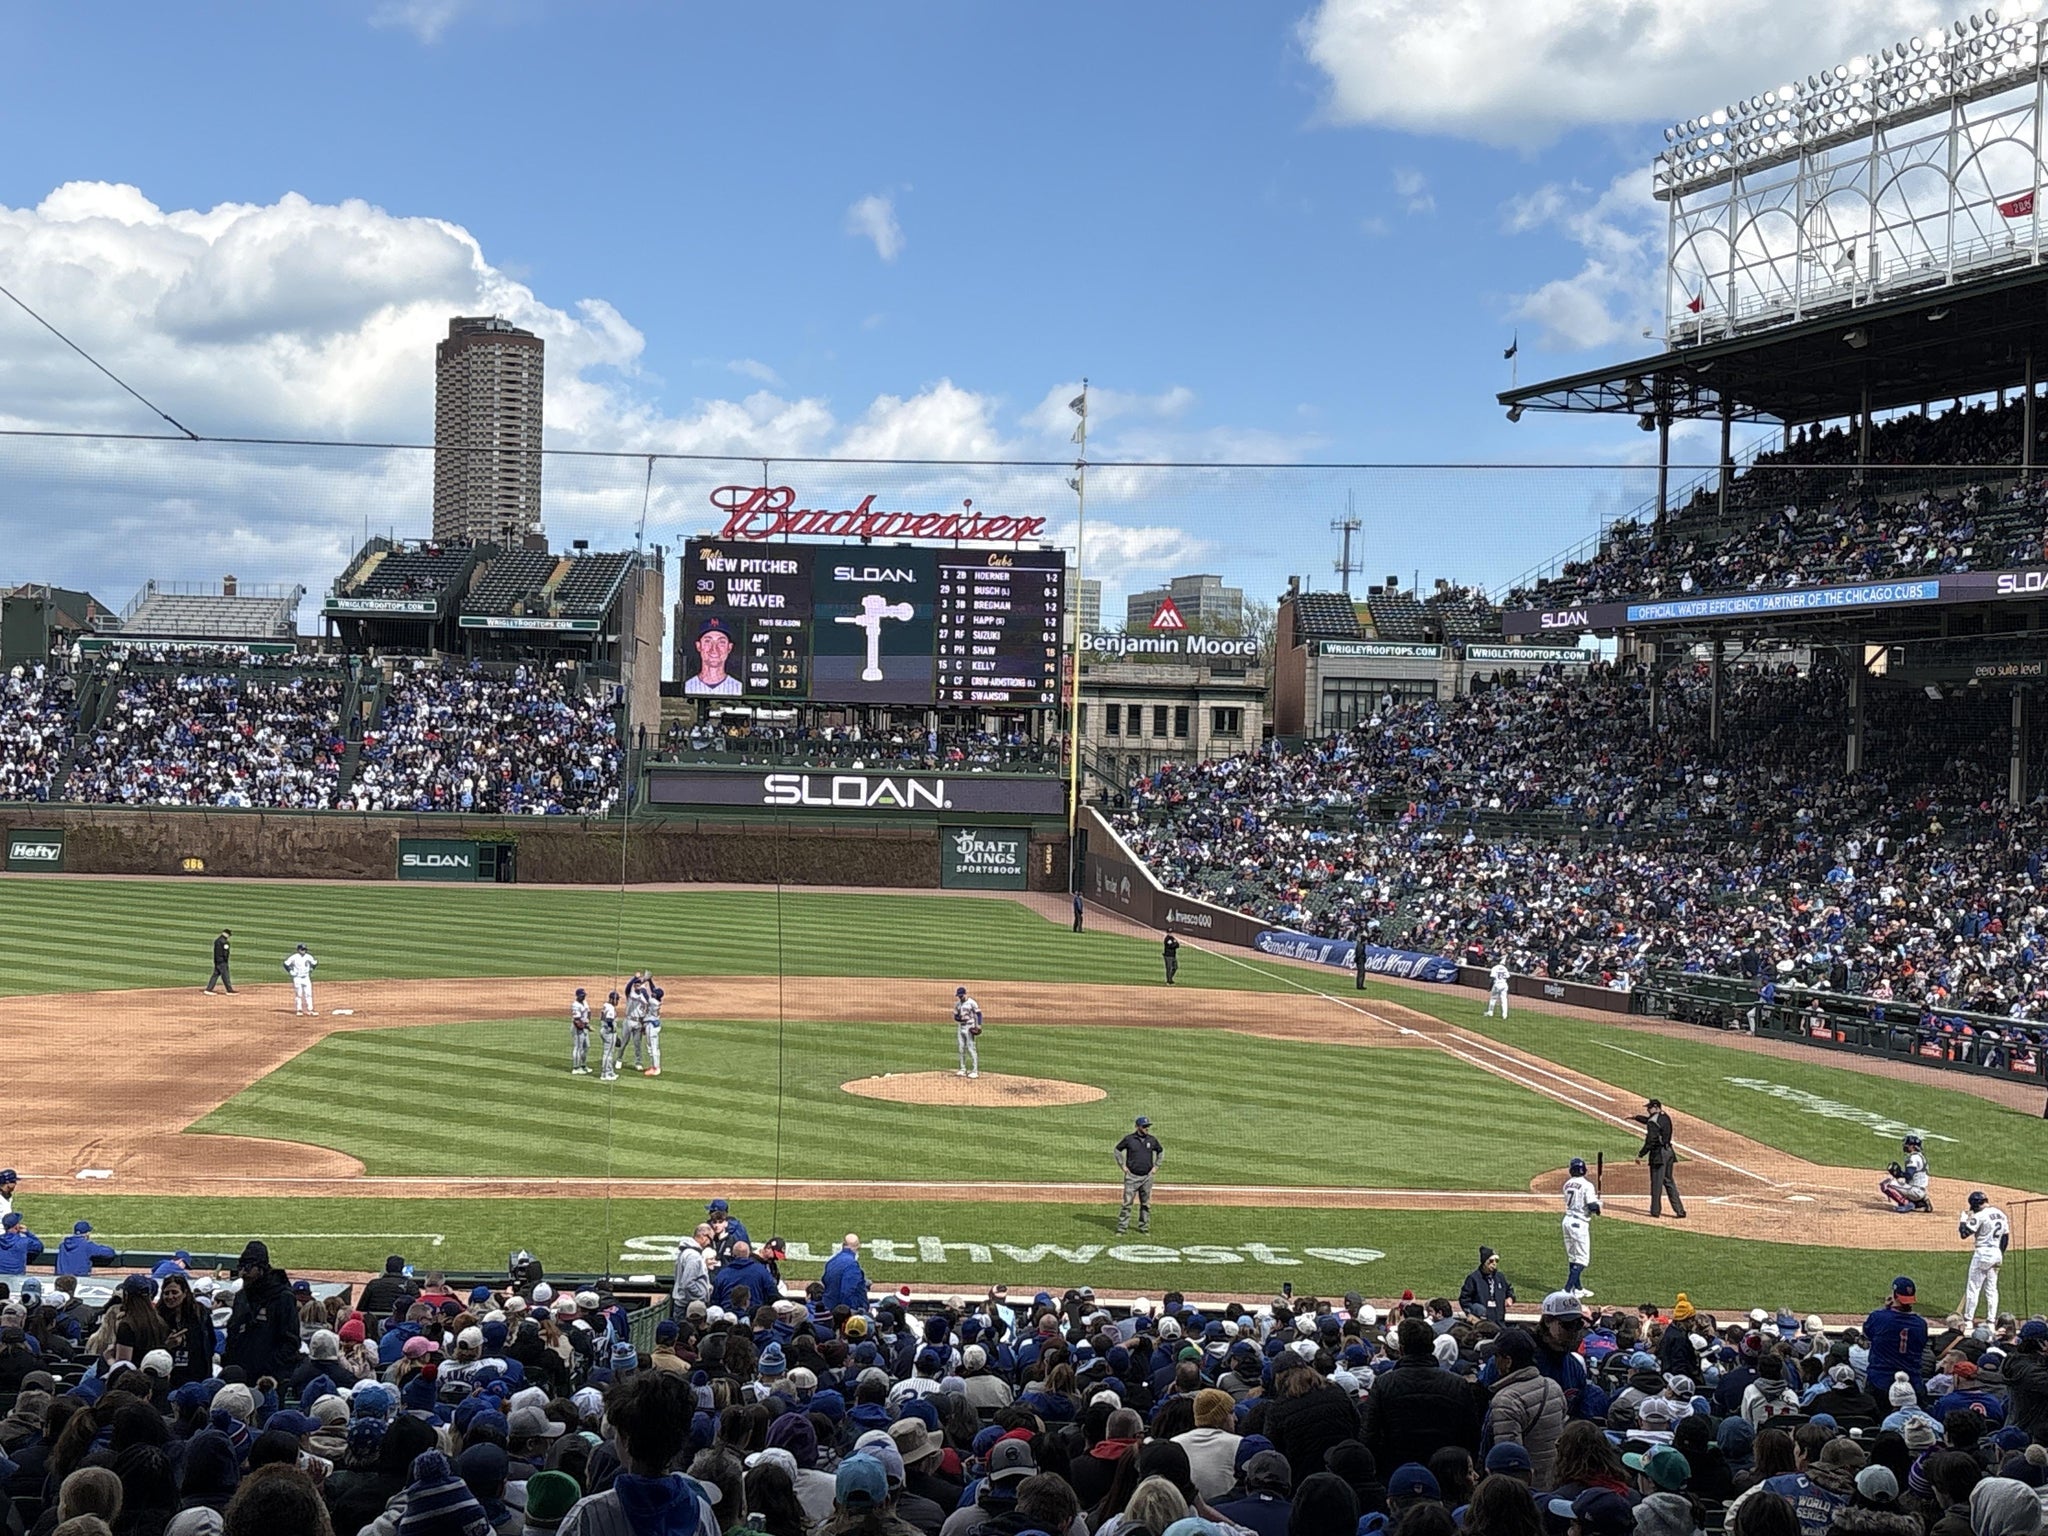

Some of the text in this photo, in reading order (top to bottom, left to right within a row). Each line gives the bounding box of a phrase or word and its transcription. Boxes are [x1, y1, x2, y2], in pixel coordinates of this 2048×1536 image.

[710, 486, 1046, 541] Budweiser
[700, 548, 723, 560] Mets
[987, 553, 1014, 566] Cubs
[706, 558, 798, 574] NEW PITCHER
[942, 570, 1058, 583] 2 2B HOERNER 1-2
[696, 580, 715, 591] 30
[727, 578, 762, 592] LUKE
[940, 584, 950, 594] 29
[956, 585, 966, 595] 1B
[973, 586, 1000, 596] BUSCH
[1043, 588, 1058, 597] 0-3
[694, 595, 715, 605] RHP
[727, 593, 785, 608] WEAVER
[941, 599, 948, 609] 3
[973, 601, 1011, 610] BREGMAN
[1045, 602, 1057, 612] 1-2
[1638, 585, 1923, 618] OFFICIAL WATER EFFICIENCY PARTNER OF THE CHICAGO CUBS
[758, 618, 801, 627] THIS SEASON
[955, 615, 965, 624] LF
[973, 615, 995, 625] HAPP
[1044, 618, 1057, 627] 1-2
[751, 633, 793, 645] APP 9
[938, 629, 1056, 642] 27 RF SUZUKI 0-3
[940, 644, 946, 654] 6
[953, 645, 965, 654] PH
[972, 645, 996, 655] SHAW
[1079, 632, 1257, 657] Benjamin Moore
[1326, 643, 1437, 657] WRIGLEYROOFTOPS.COM
[756, 648, 795, 659] IP 7.1
[1472, 648, 1585, 661] WRIGLEYROOFTOPS.COM
[751, 663, 798, 674] ERA 7.36
[938, 660, 1055, 673] 15 C KELLY P6
[1975, 662, 2042, 677] eero suite level
[749, 678, 797, 689] WHIP 1.23
[939, 675, 946, 685] 4
[953, 676, 964, 685] CF
[939, 690, 1054, 703] 7 SS SWANSON 0-2
[13, 845, 57, 859] Hefty
[956, 840, 1018, 854] DRAFT
[964, 852, 1016, 864] KINGS
[956, 864, 1021, 874] SPORTSBOOK
[1175, 909, 1198, 926] Invesco
[1383, 953, 1413, 977] Wrap
[1566, 1190, 1574, 1207] 7
[1992, 1221, 2002, 1239] 2
[1798, 1495, 1831, 1512] WORLD
[1796, 1507, 1828, 1523] SERIES
